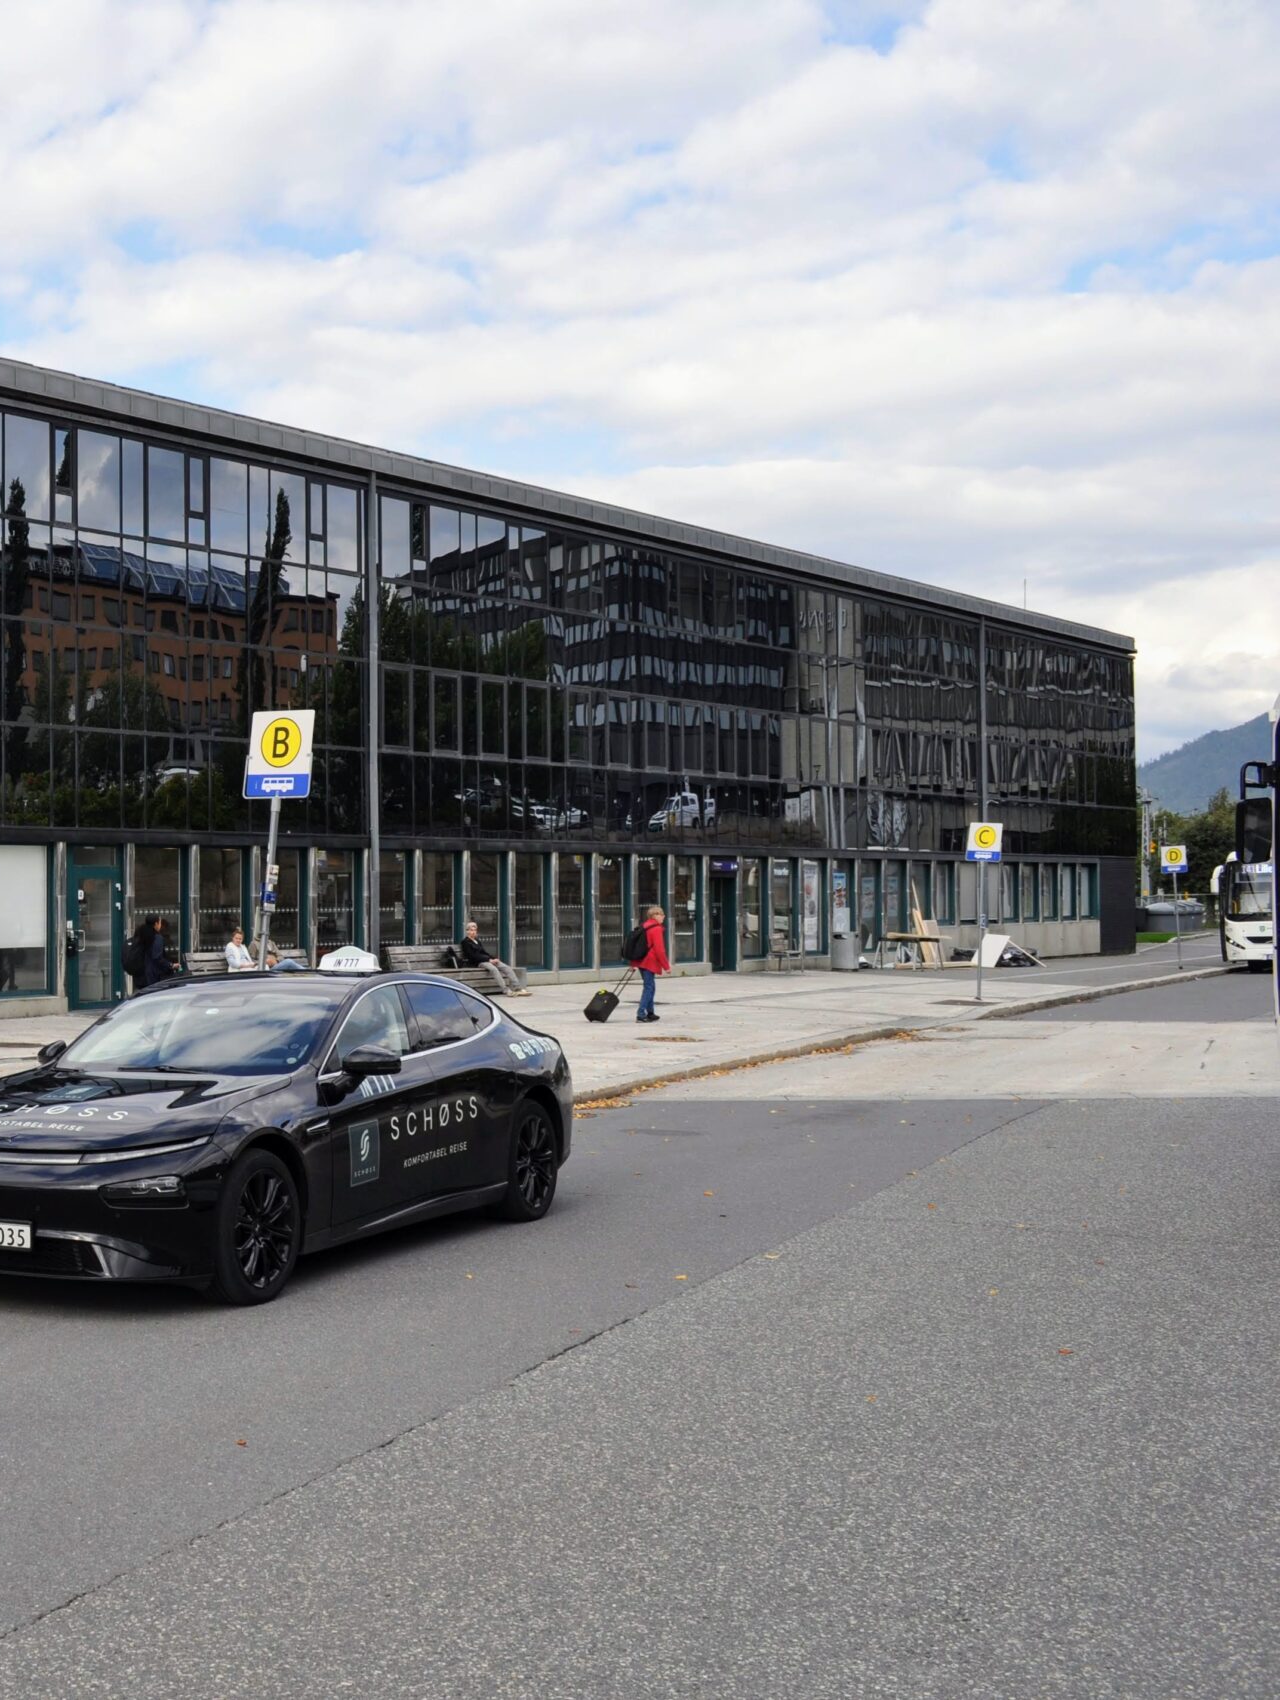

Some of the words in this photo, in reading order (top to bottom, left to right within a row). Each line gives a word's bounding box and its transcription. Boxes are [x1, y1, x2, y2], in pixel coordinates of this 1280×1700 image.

[272, 727, 290, 758] B
[979, 829, 990, 845] C
[1169, 851, 1179, 861] D
[333, 958, 344, 968] IN
[344, 958, 359, 968] 777
[390, 1096, 478, 1141] SCHØSS
[48, 1122, 85, 1132] REISE
[403, 1147, 447, 1168] KOMFORTABEL
[449, 1141, 468, 1155] REISE
